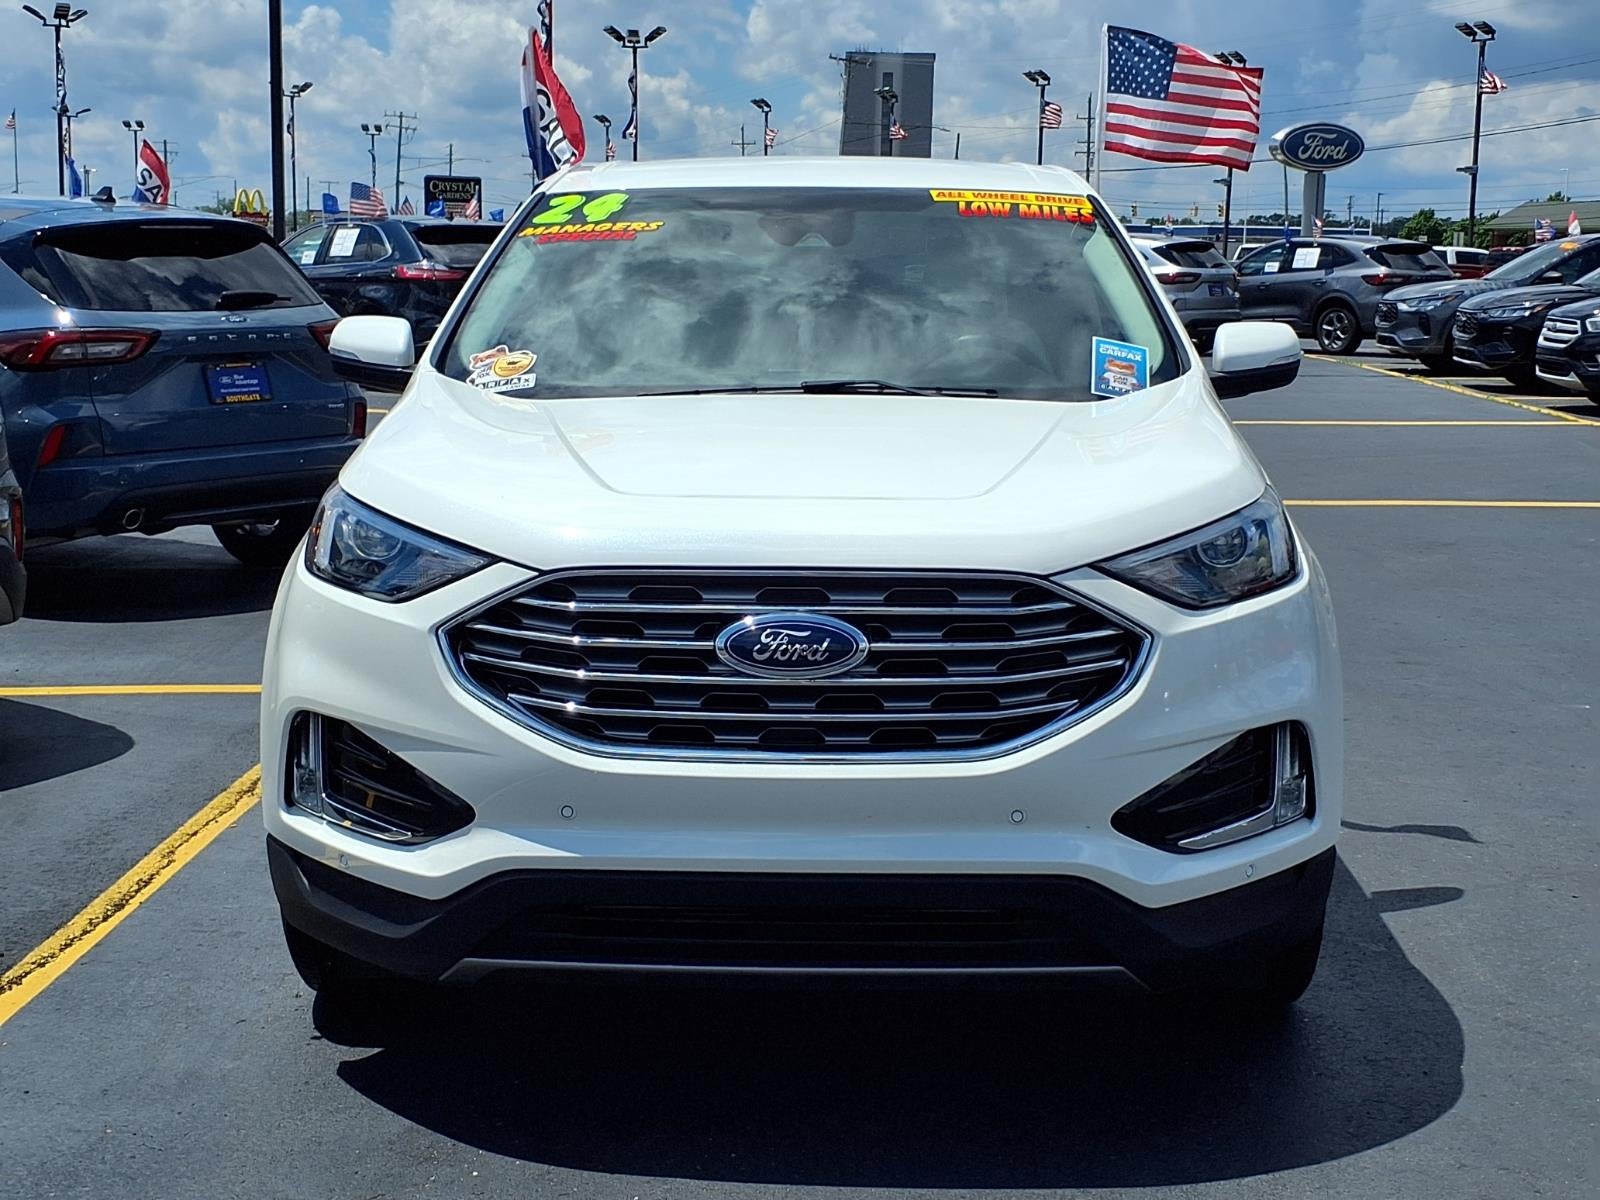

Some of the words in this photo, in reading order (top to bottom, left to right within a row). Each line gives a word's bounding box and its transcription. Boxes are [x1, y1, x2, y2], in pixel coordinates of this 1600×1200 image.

[1298, 132, 1349, 160] Ford
[429, 180, 475, 194] CRYSTAL
[935, 191, 967, 199] ALL
[972, 192, 1030, 202] WHEEL
[1034, 194, 1086, 205] DRIVE
[532, 192, 630, 224] 24
[958, 201, 1011, 217] LOW
[1019, 203, 1096, 225] MILES
[518, 221, 665, 237] MANAGERS
[534, 231, 637, 244] SPECIAL
[1099, 347, 1142, 361] CARFAX
[752, 628, 831, 661] Ford
